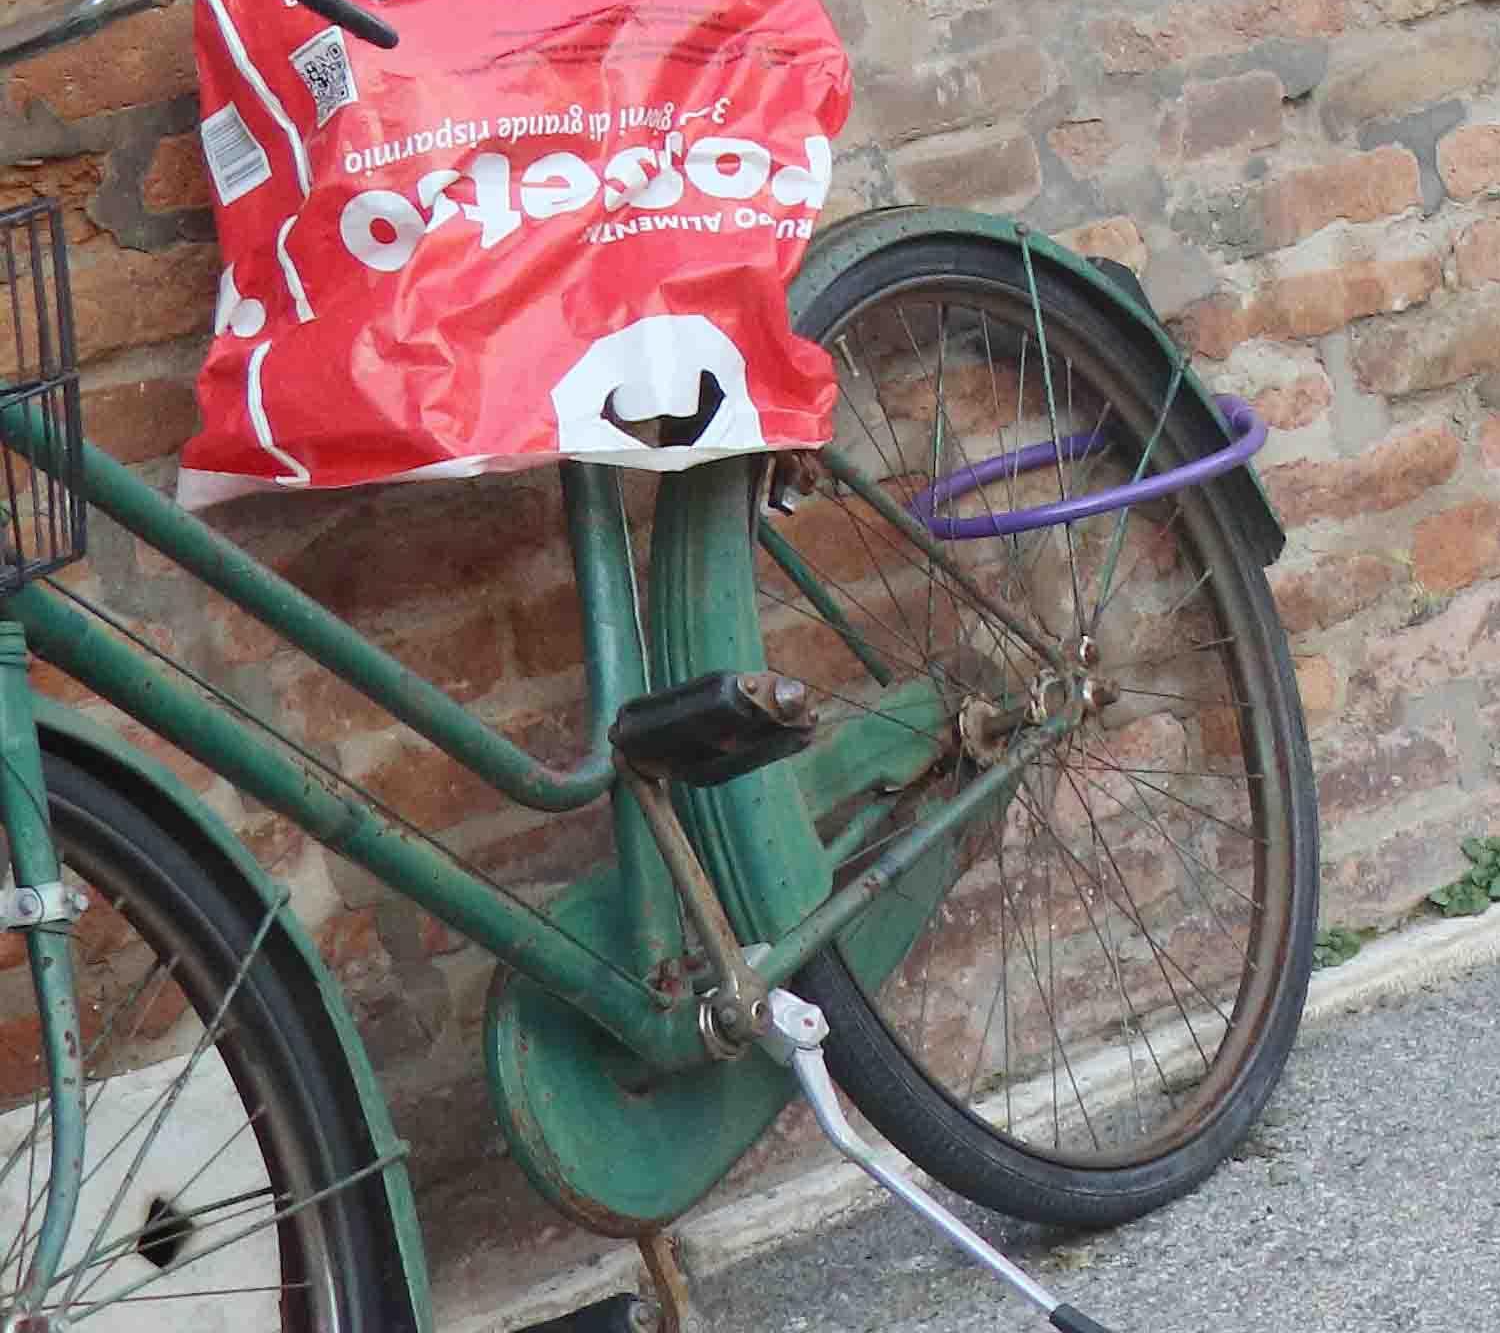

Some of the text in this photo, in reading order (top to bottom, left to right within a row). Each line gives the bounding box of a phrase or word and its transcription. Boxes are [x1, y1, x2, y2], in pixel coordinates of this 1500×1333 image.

[496, 104, 584, 145] grande
[587, 112, 612, 140] di
[343, 118, 491, 174] risparmio
